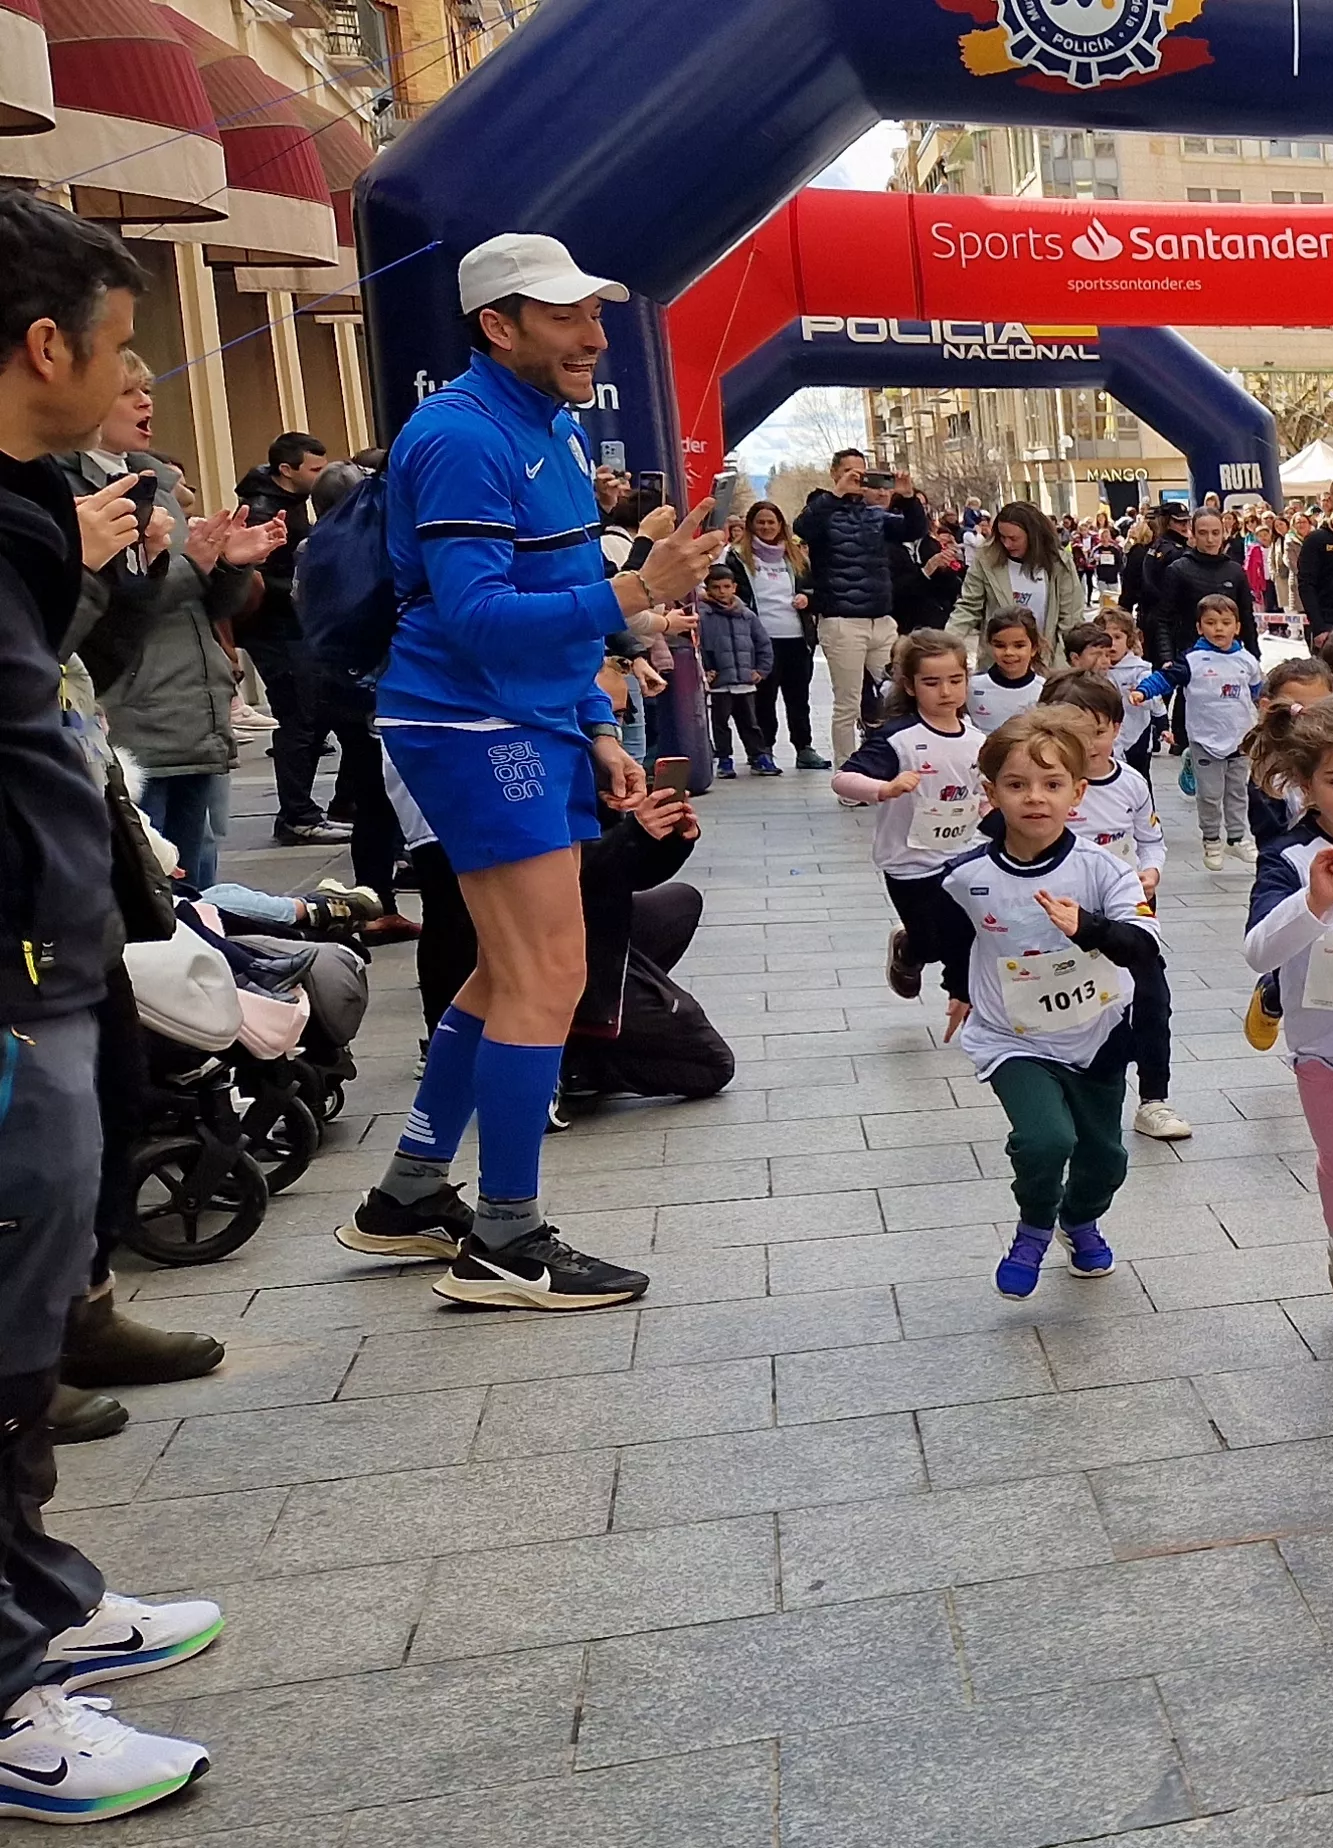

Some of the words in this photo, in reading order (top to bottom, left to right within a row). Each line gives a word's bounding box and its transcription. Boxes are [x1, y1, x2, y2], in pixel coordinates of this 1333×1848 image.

[1052, 33, 1115, 53] POLICÍA
[931, 222, 1064, 268] Sports
[1129, 226, 1333, 261] Santander
[1067, 276, 1202, 293] sportssantander.es
[943, 343, 1100, 360] NACIONAL
[1087, 467, 1148, 482] MANGO
[1219, 463, 1263, 490] RUTA
[1038, 979, 1096, 1013] 1013
